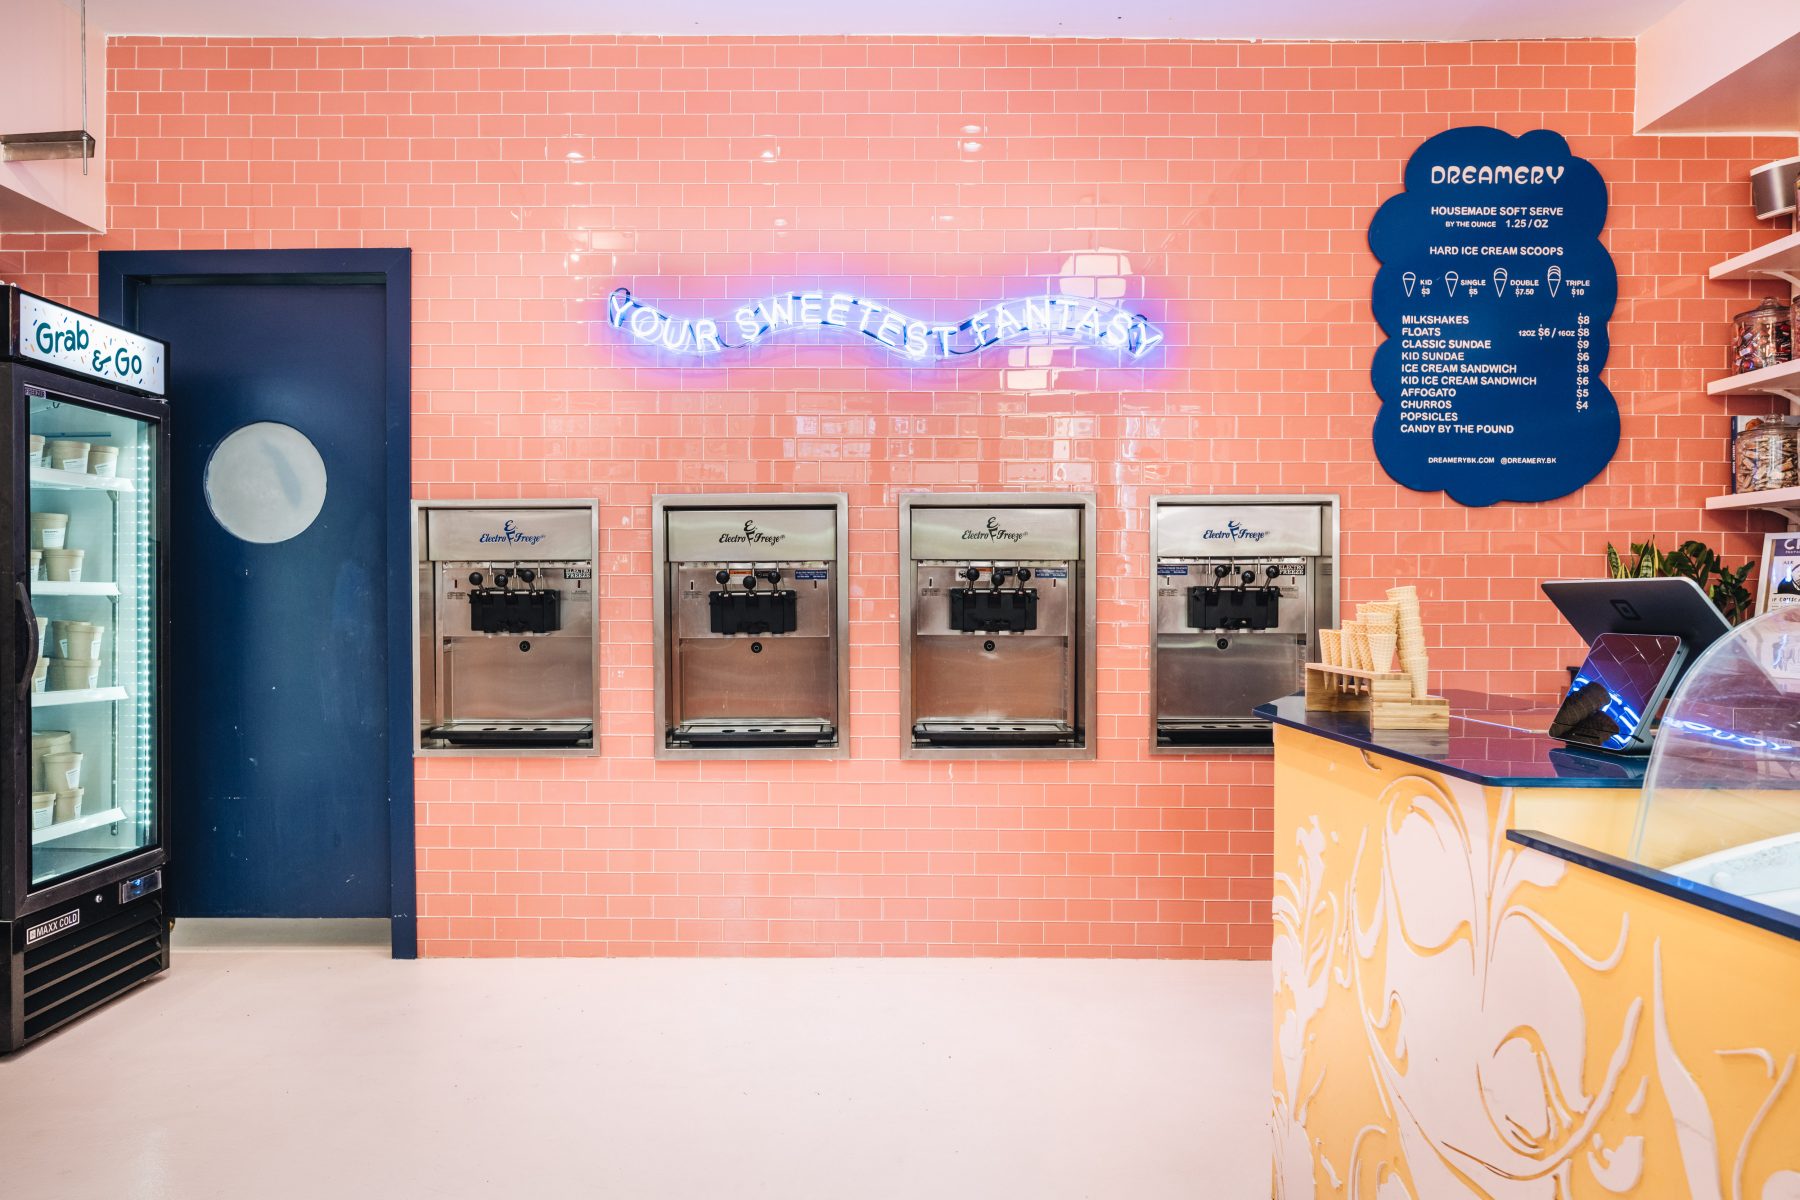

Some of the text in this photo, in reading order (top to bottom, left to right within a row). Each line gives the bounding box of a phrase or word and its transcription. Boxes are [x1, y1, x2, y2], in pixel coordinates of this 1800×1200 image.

[1431, 166, 1565, 184] DREAMERY
[1431, 207, 1564, 216] HOUSEMADE SOFT SERVE
[1506, 219, 1527, 228] 1.25
[1534, 219, 1549, 228] OZ
[1429, 246, 1564, 256] HARD ICE CREAM SCOOPS
[1421, 286, 1430, 296] $3
[1469, 287, 1478, 296] $5
[1515, 287, 1535, 296] $7.50
[1571, 287, 1584, 296] $10
[1402, 313, 1590, 325] MILKSHAKES $8
[610, 292, 1162, 358] YOUR SWEETEST FANTASY
[1402, 328, 1441, 336] FLOATS
[1538, 324, 1550, 339] $6
[1578, 327, 1590, 337] $8
[36, 320, 89, 354] Grab
[1402, 339, 1589, 349] CLASSIC SUNDAE $9
[1402, 351, 1590, 362] KID SUNDAE $6
[92, 348, 142, 376] & Go
[1401, 363, 1589, 374] ICE CREAM SANDWICH $8
[1422, 376, 1438, 385] ICE
[1441, 376, 1478, 385] CREAM
[1480, 377, 1536, 386] SANDWICH
[1576, 375, 1589, 386] $6
[1401, 388, 1589, 398] AFFOGATO $5
[1401, 399, 1589, 411] CHURROS $4
[1400, 412, 1458, 421] POPSICLES
[1400, 424, 1514, 434] CANDY BY THE POUND
[1501, 457, 1556, 465] @DREAMERY.BK
[479, 533, 506, 543] Electro
[719, 533, 746, 543] Electro
[962, 530, 988, 540] Electro
[1203, 530, 1230, 540] Electro
[36, 913, 77, 936] MAXX COLD
